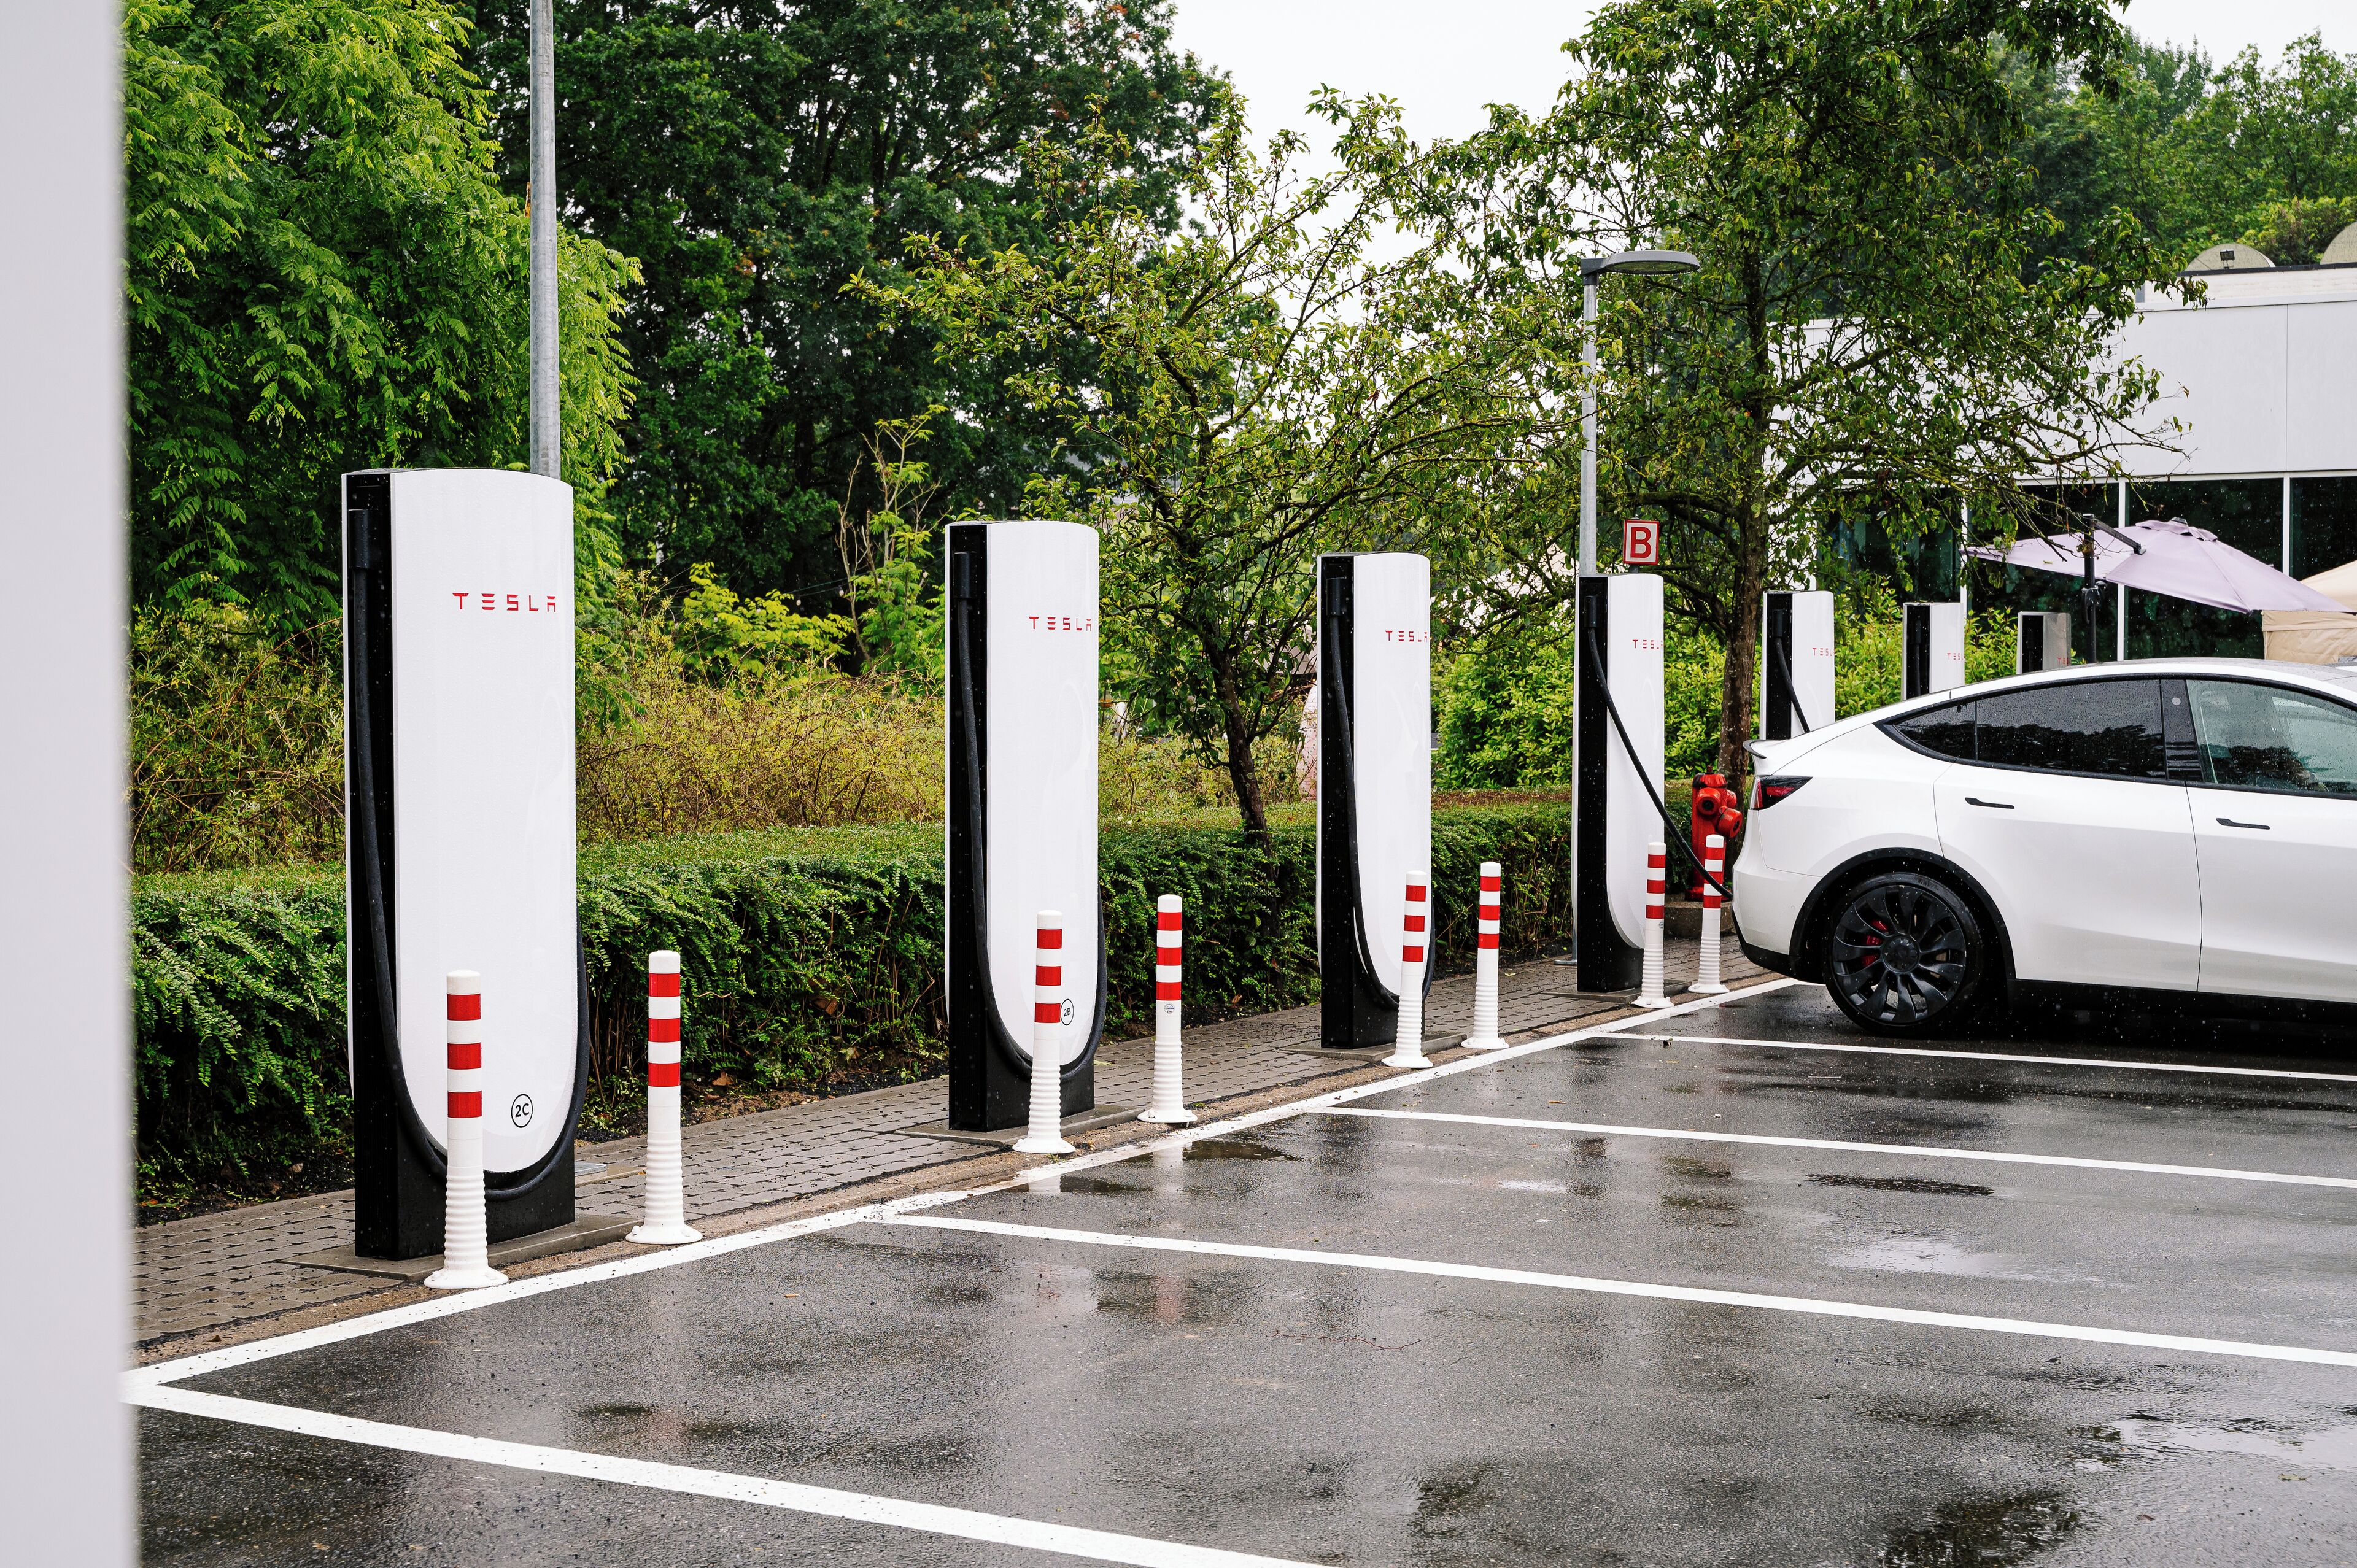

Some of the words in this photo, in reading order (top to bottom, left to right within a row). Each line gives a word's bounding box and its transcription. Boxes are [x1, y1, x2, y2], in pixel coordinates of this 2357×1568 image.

[1630, 527, 1652, 558] B
[452, 592, 556, 612] TESLA
[1028, 616, 1091, 631] TESLA
[1385, 630, 1428, 643] TESLA
[1812, 647, 1834, 657] TESL
[1063, 1007, 1071, 1017] 2B
[515, 1103, 530, 1118] 2C
